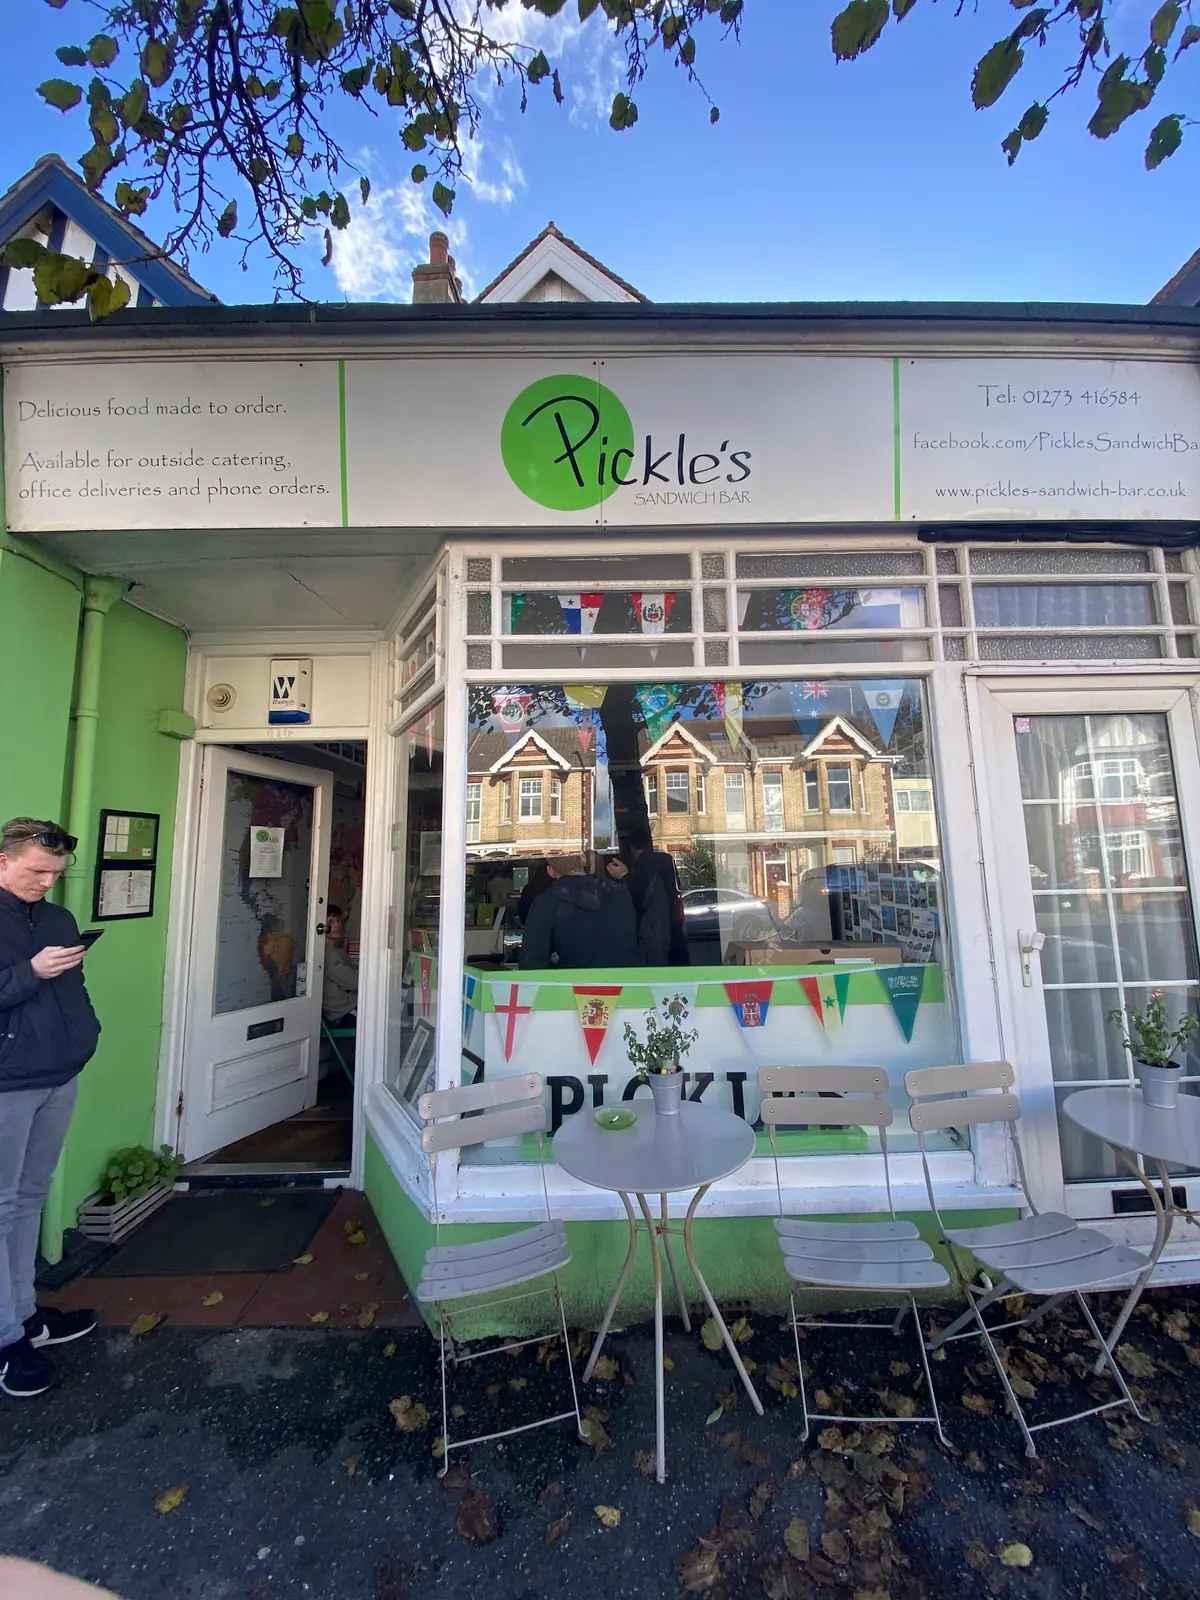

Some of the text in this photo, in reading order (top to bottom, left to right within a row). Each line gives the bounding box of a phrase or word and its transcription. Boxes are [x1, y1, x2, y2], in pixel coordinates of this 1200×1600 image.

[18, 395, 288, 422] Delicious food made to order.
[1022, 390, 1073, 407] 01273
[1080, 388, 1141, 408] 416584
[521, 395, 752, 488] Pickle's
[18, 448, 291, 473] Available for outside catering,
[18, 476, 331, 504] office deliveries and phone orders.
[633, 490, 751, 505] SANDWICH BAR
[935, 480, 1187, 503] www.pickles-sandwich-bar.co.uk
